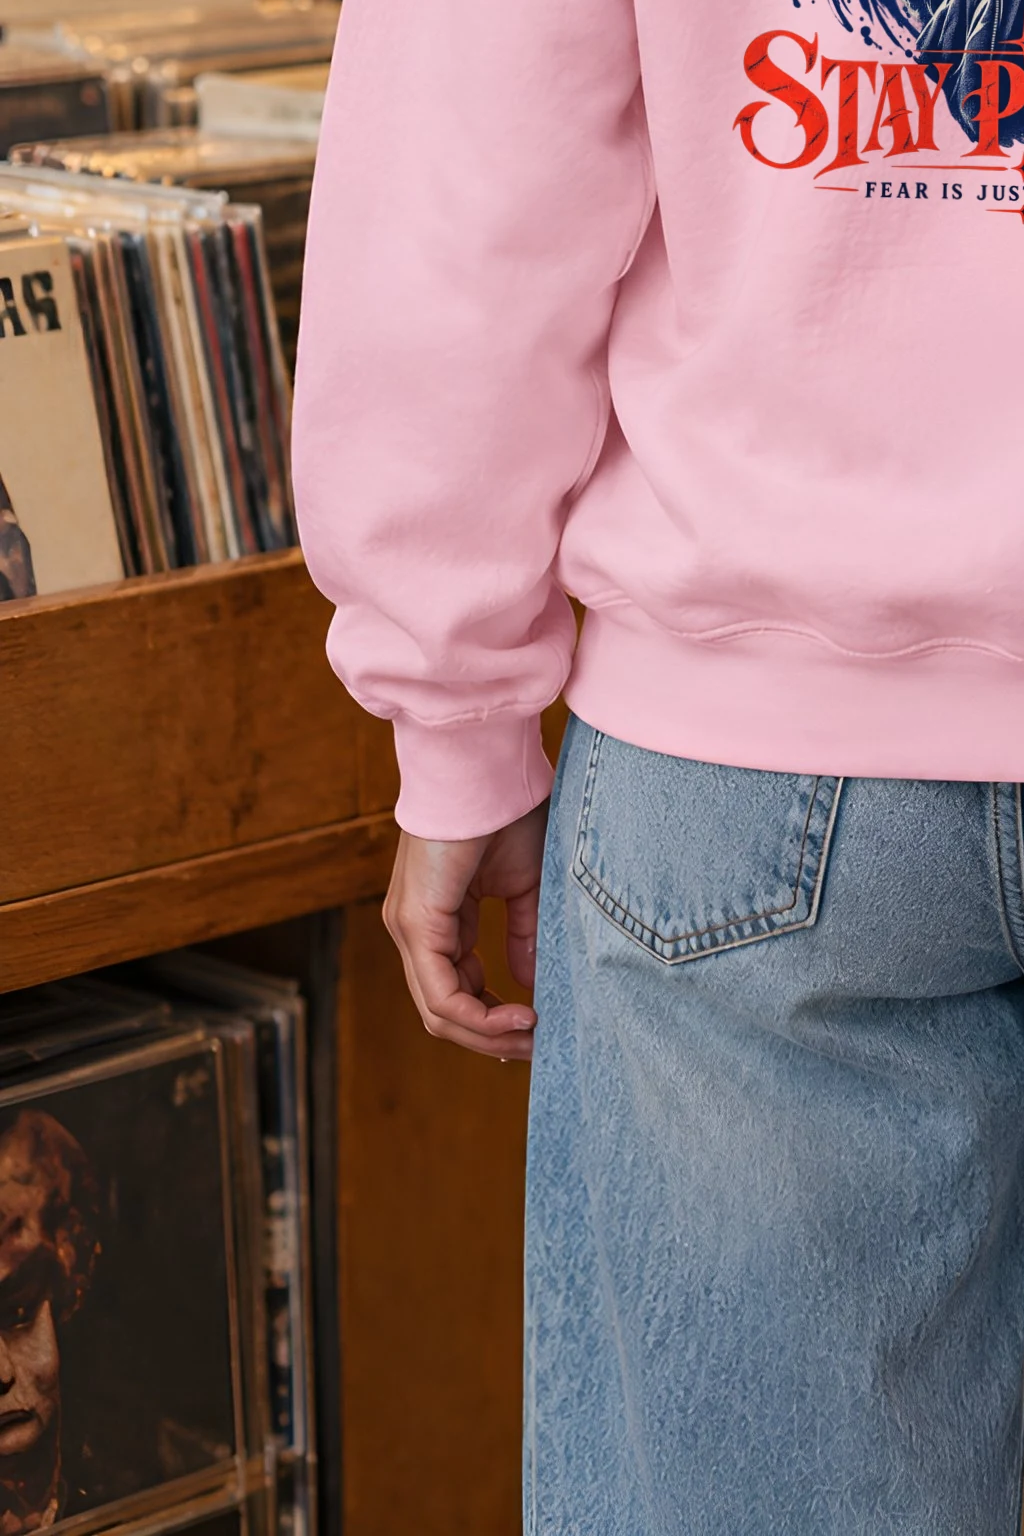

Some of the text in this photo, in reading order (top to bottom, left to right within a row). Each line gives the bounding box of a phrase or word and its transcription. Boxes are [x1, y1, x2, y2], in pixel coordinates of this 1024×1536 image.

[732, 29, 953, 180] STAY
[864, 181, 929, 200] FEAR
[941, 182, 963, 201] IS
